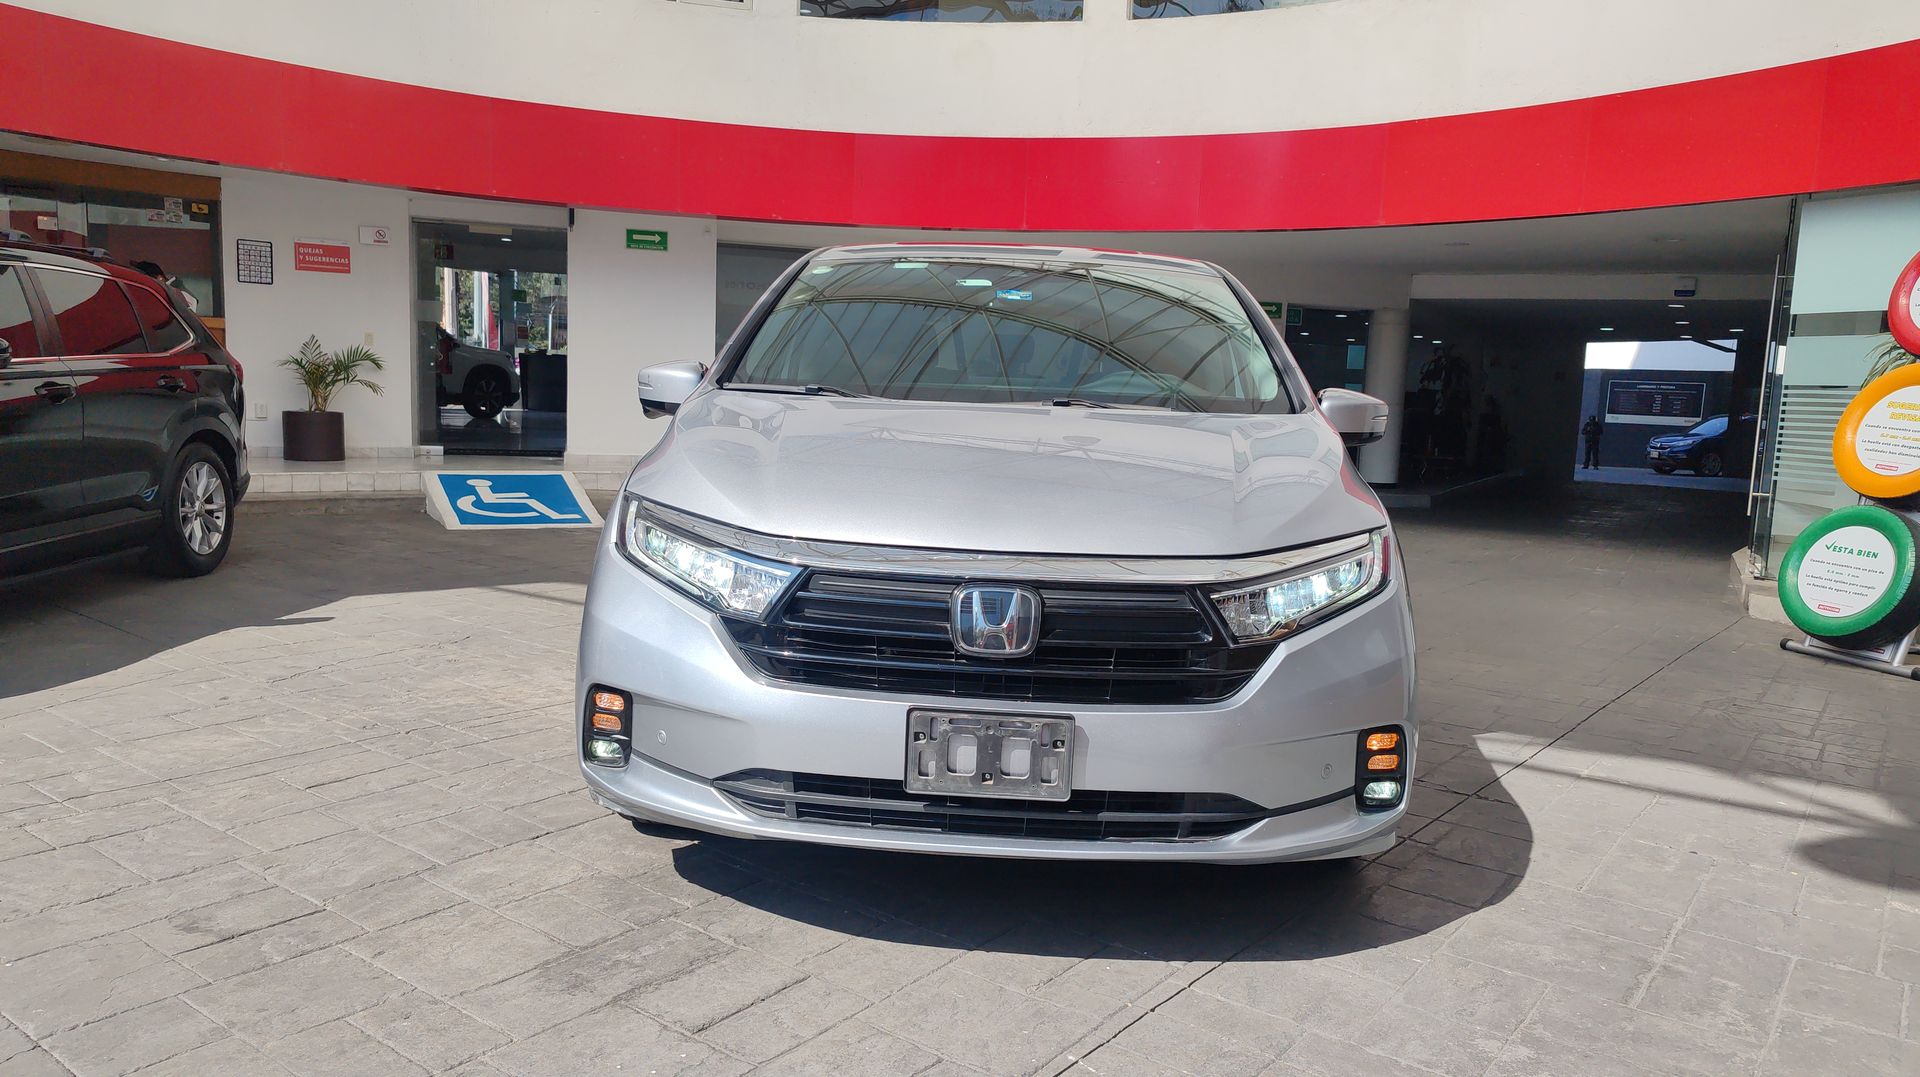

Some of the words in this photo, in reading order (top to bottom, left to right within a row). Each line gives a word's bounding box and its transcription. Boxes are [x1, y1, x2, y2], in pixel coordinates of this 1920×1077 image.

[305, 256, 349, 264] SUGERENCIAS
[1832, 545, 1854, 555] ESTA
[1857, 549, 1879, 559] BIEN
